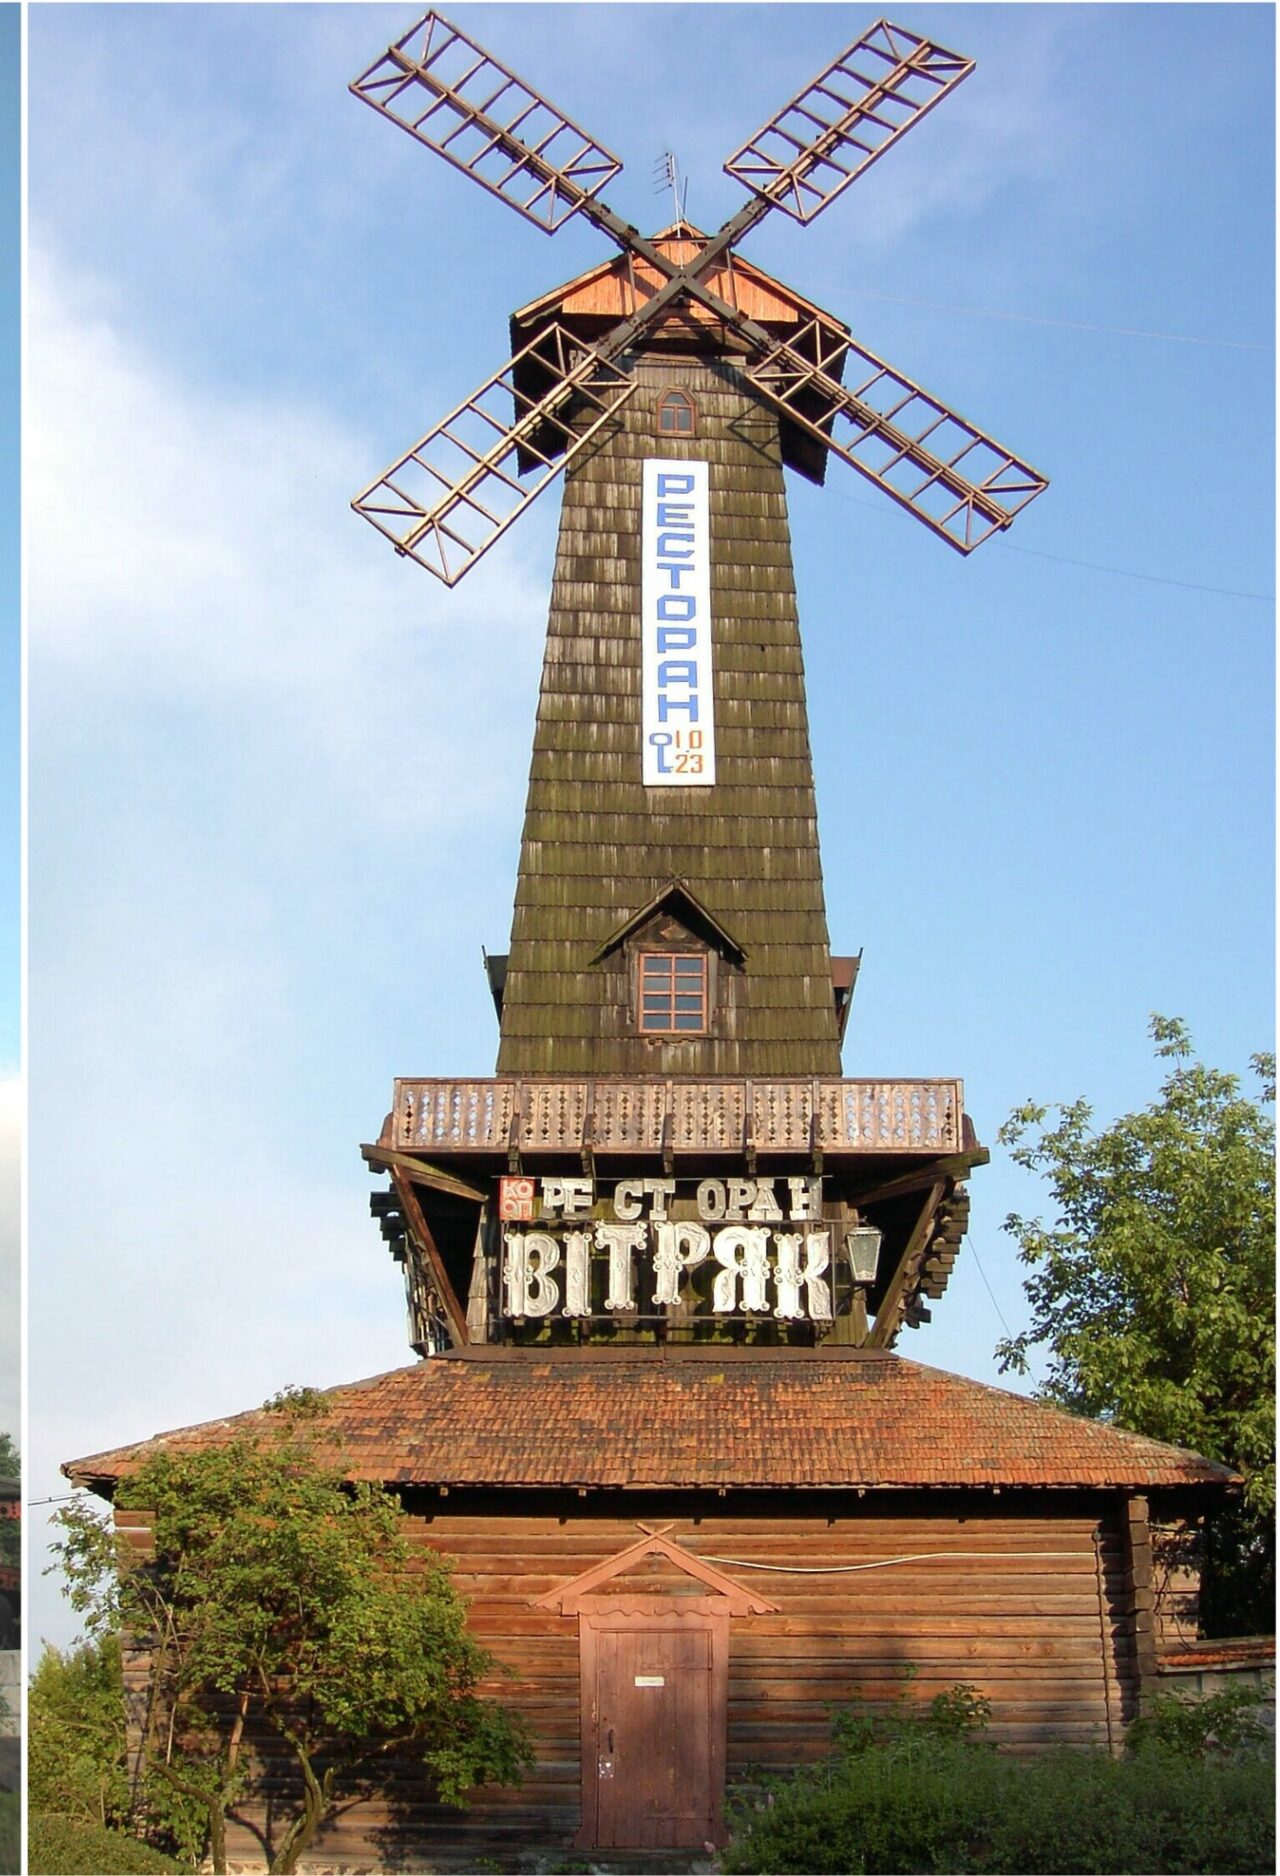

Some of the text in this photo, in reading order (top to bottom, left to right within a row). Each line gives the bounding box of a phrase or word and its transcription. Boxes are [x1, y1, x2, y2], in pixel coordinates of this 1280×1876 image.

[657, 473, 699, 722] РЕСТОРАН
[675, 754, 704, 773] 23
[503, 1220, 832, 1320] ВІТРЯК
